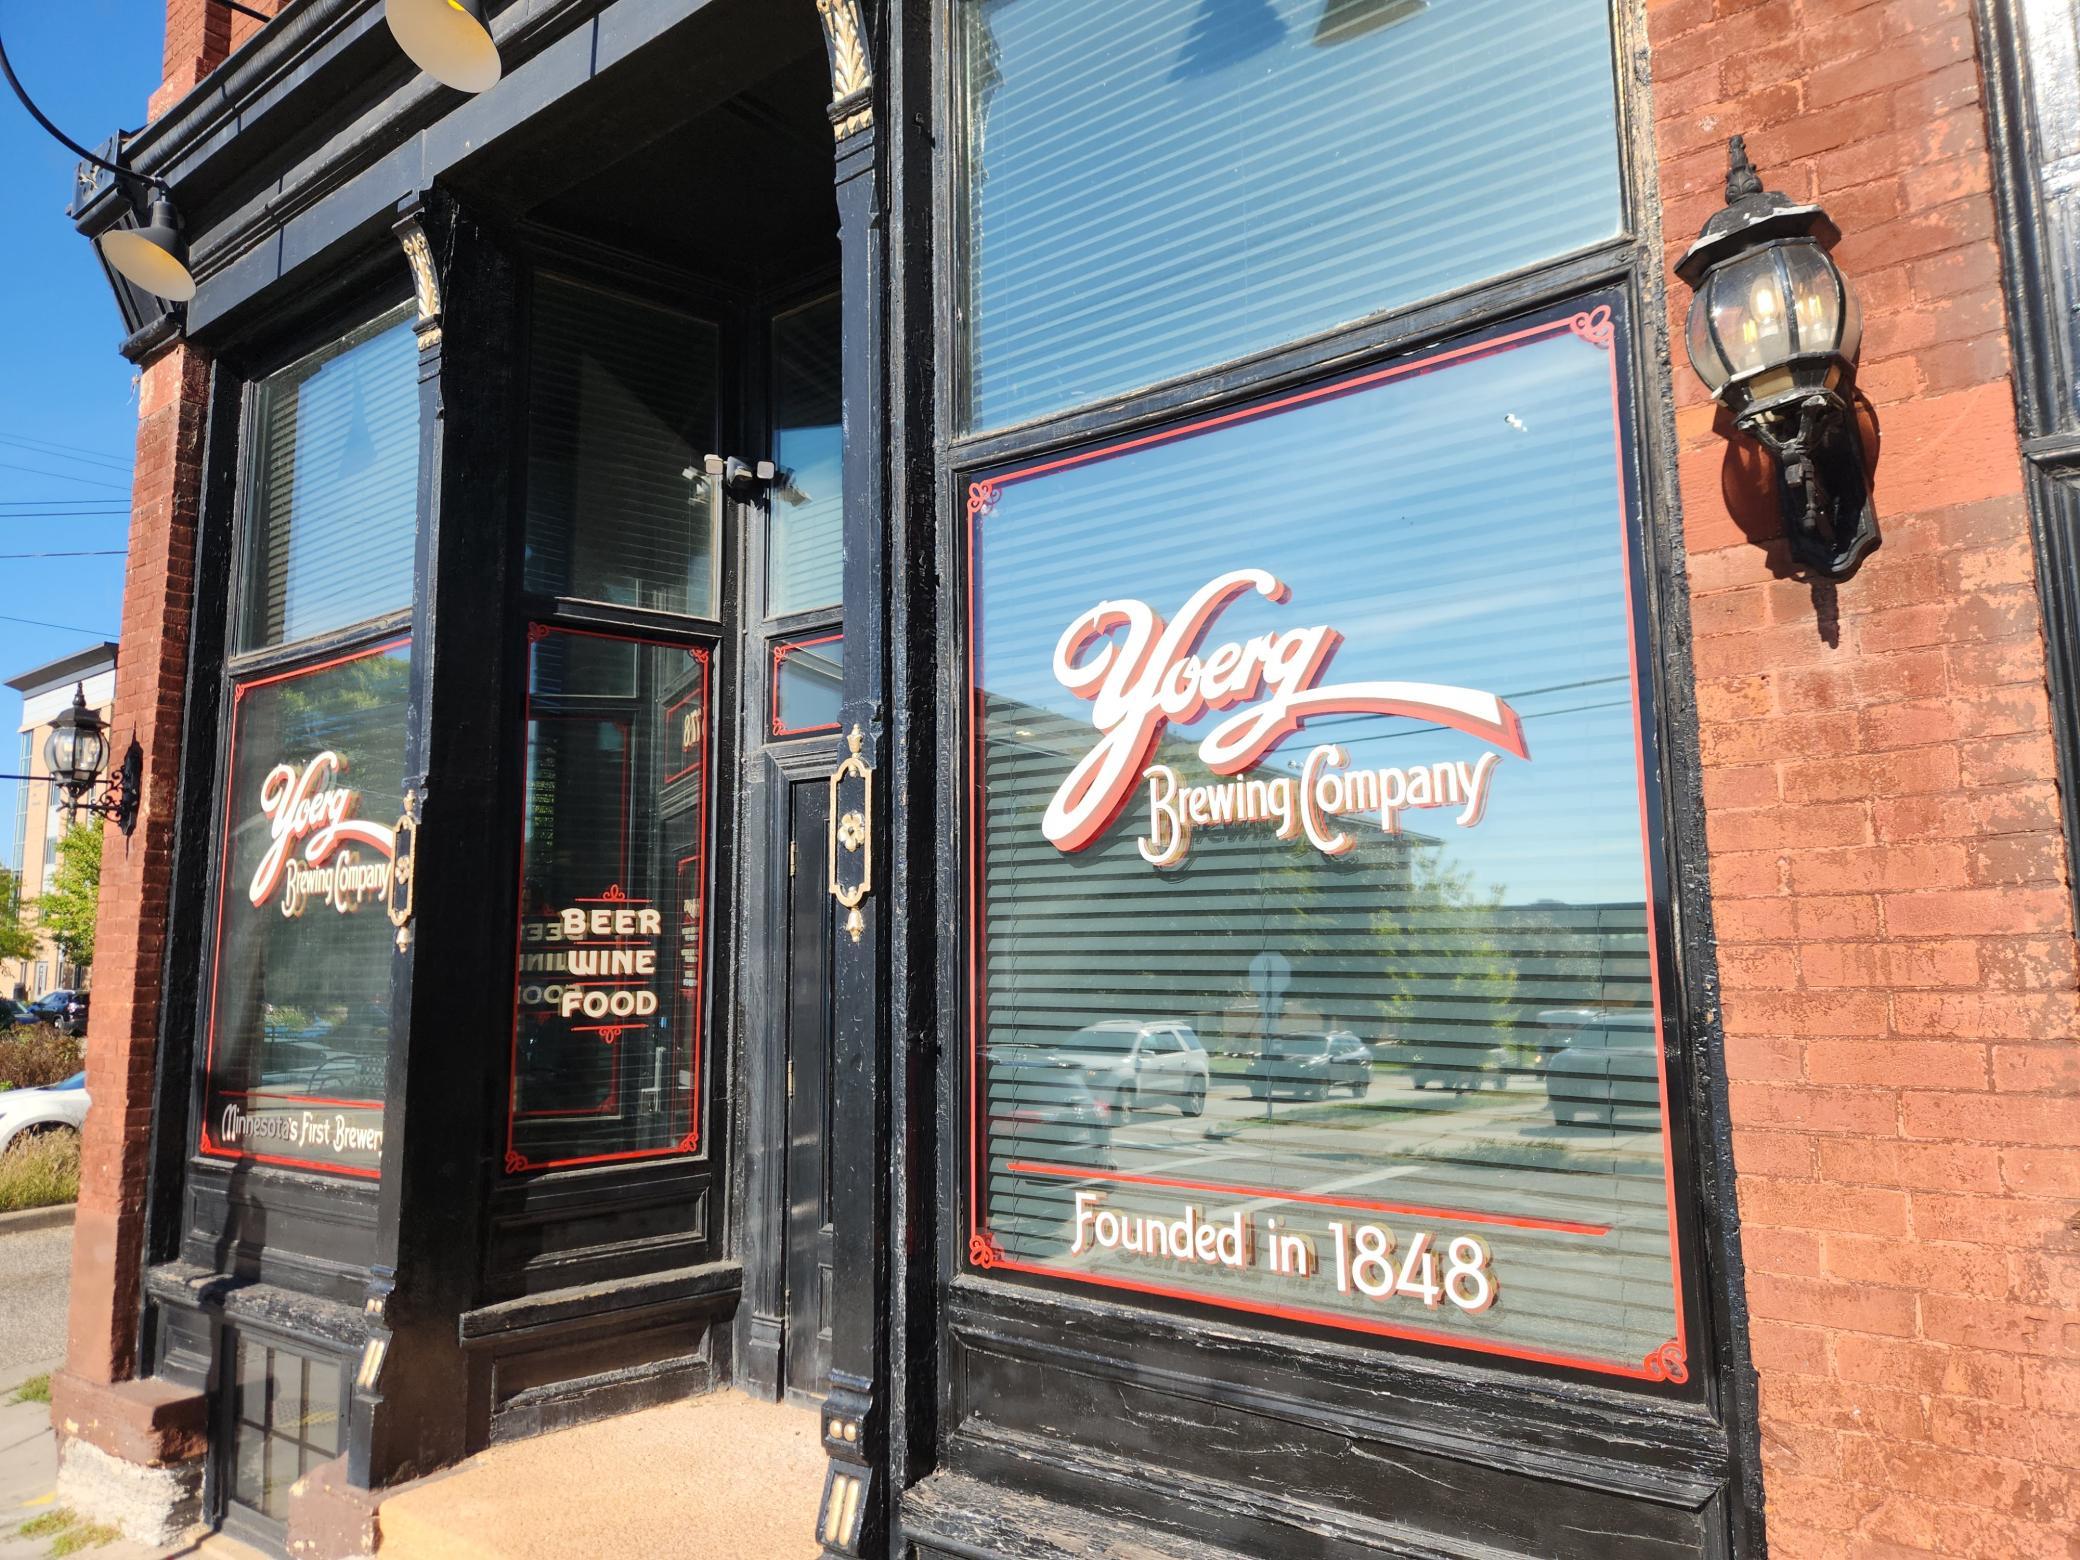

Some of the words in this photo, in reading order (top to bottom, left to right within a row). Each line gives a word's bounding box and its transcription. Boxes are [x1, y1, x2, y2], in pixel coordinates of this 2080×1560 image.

[1042, 568, 1530, 852] Yoerg
[249, 751, 393, 907] Yoerg
[1137, 764, 1295, 866] Brewing
[1299, 744, 1502, 854] Company
[281, 858, 334, 917] Brewing
[335, 850, 391, 912] Company
[561, 908, 661, 935] BEER
[568, 950, 656, 976] WINE
[562, 991, 658, 1018] FOOD
[222, 1103, 298, 1141] Minnesota's
[299, 1111, 330, 1147] First
[1071, 1191, 1249, 1266] Founded
[1268, 1217, 1314, 1277] in
[1328, 1221, 1497, 1311] 1848
